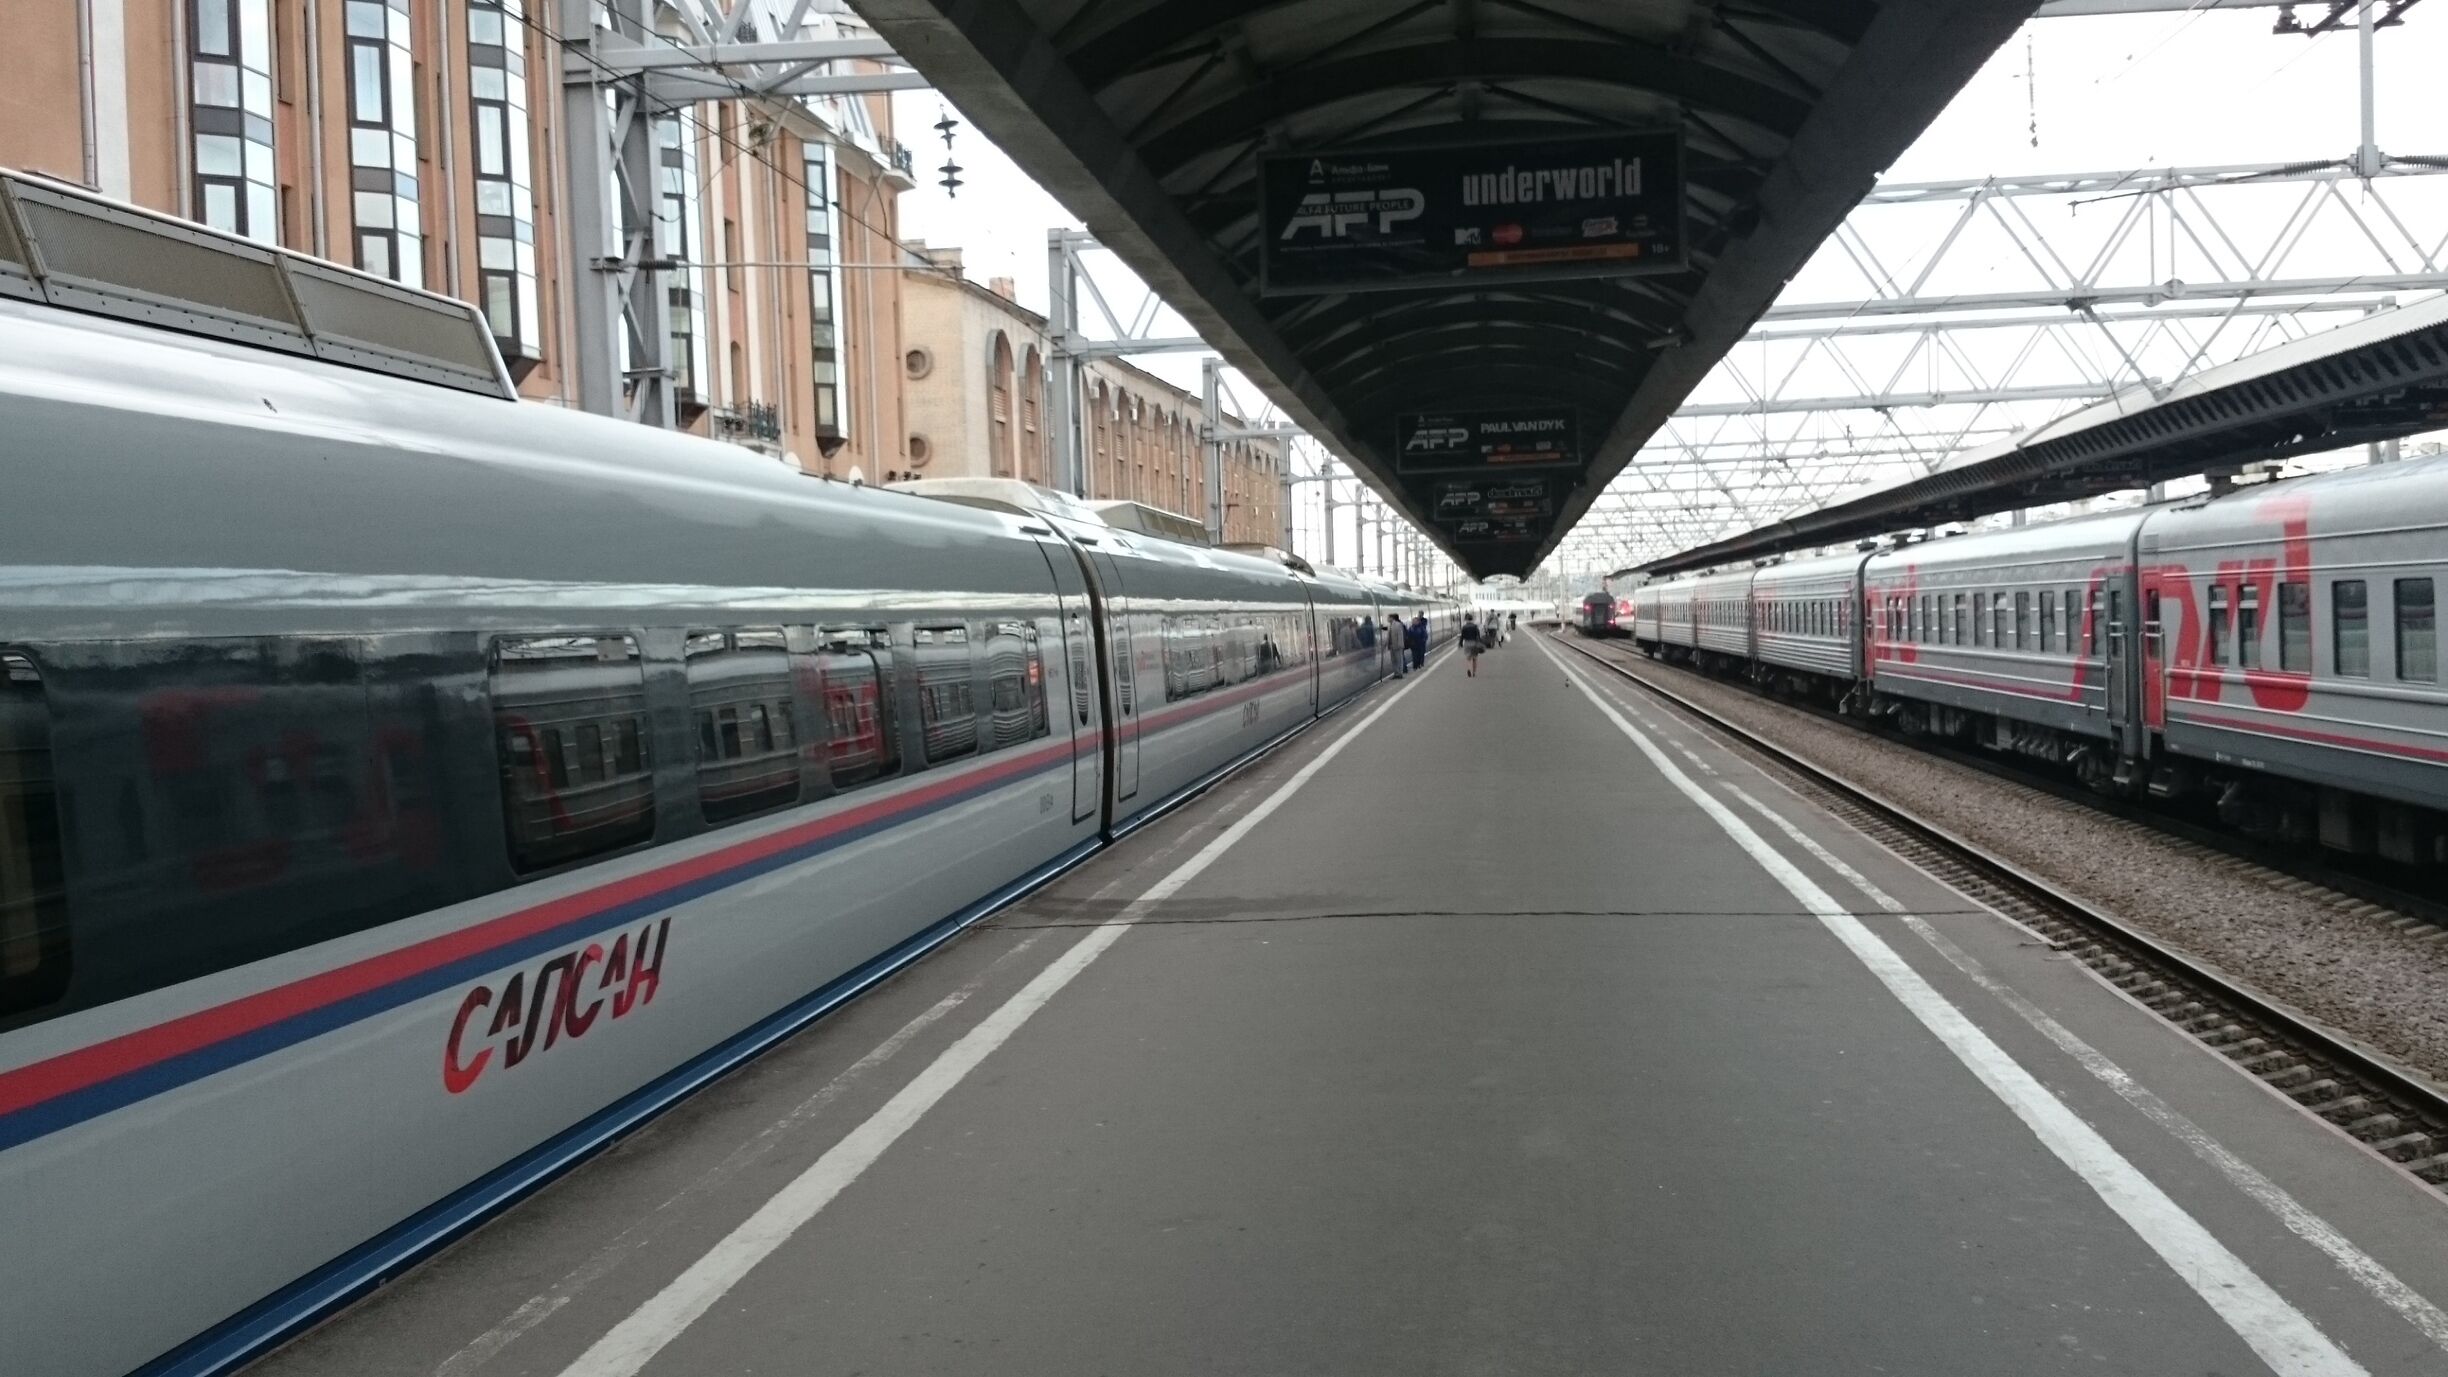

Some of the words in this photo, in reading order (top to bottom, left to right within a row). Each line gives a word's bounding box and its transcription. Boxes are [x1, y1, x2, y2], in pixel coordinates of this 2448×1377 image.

[1462, 156, 1641, 206] underworld
[1280, 188, 1425, 240] AFP
[1325, 201, 1364, 215] FUTURE
[1369, 198, 1410, 210] PEOPLE
[1480, 421, 1512, 434] PAUL
[1405, 428, 1469, 450] AFP
[1440, 491, 1481, 506] AFP
[443, 916, 671, 1094] САПСАН
